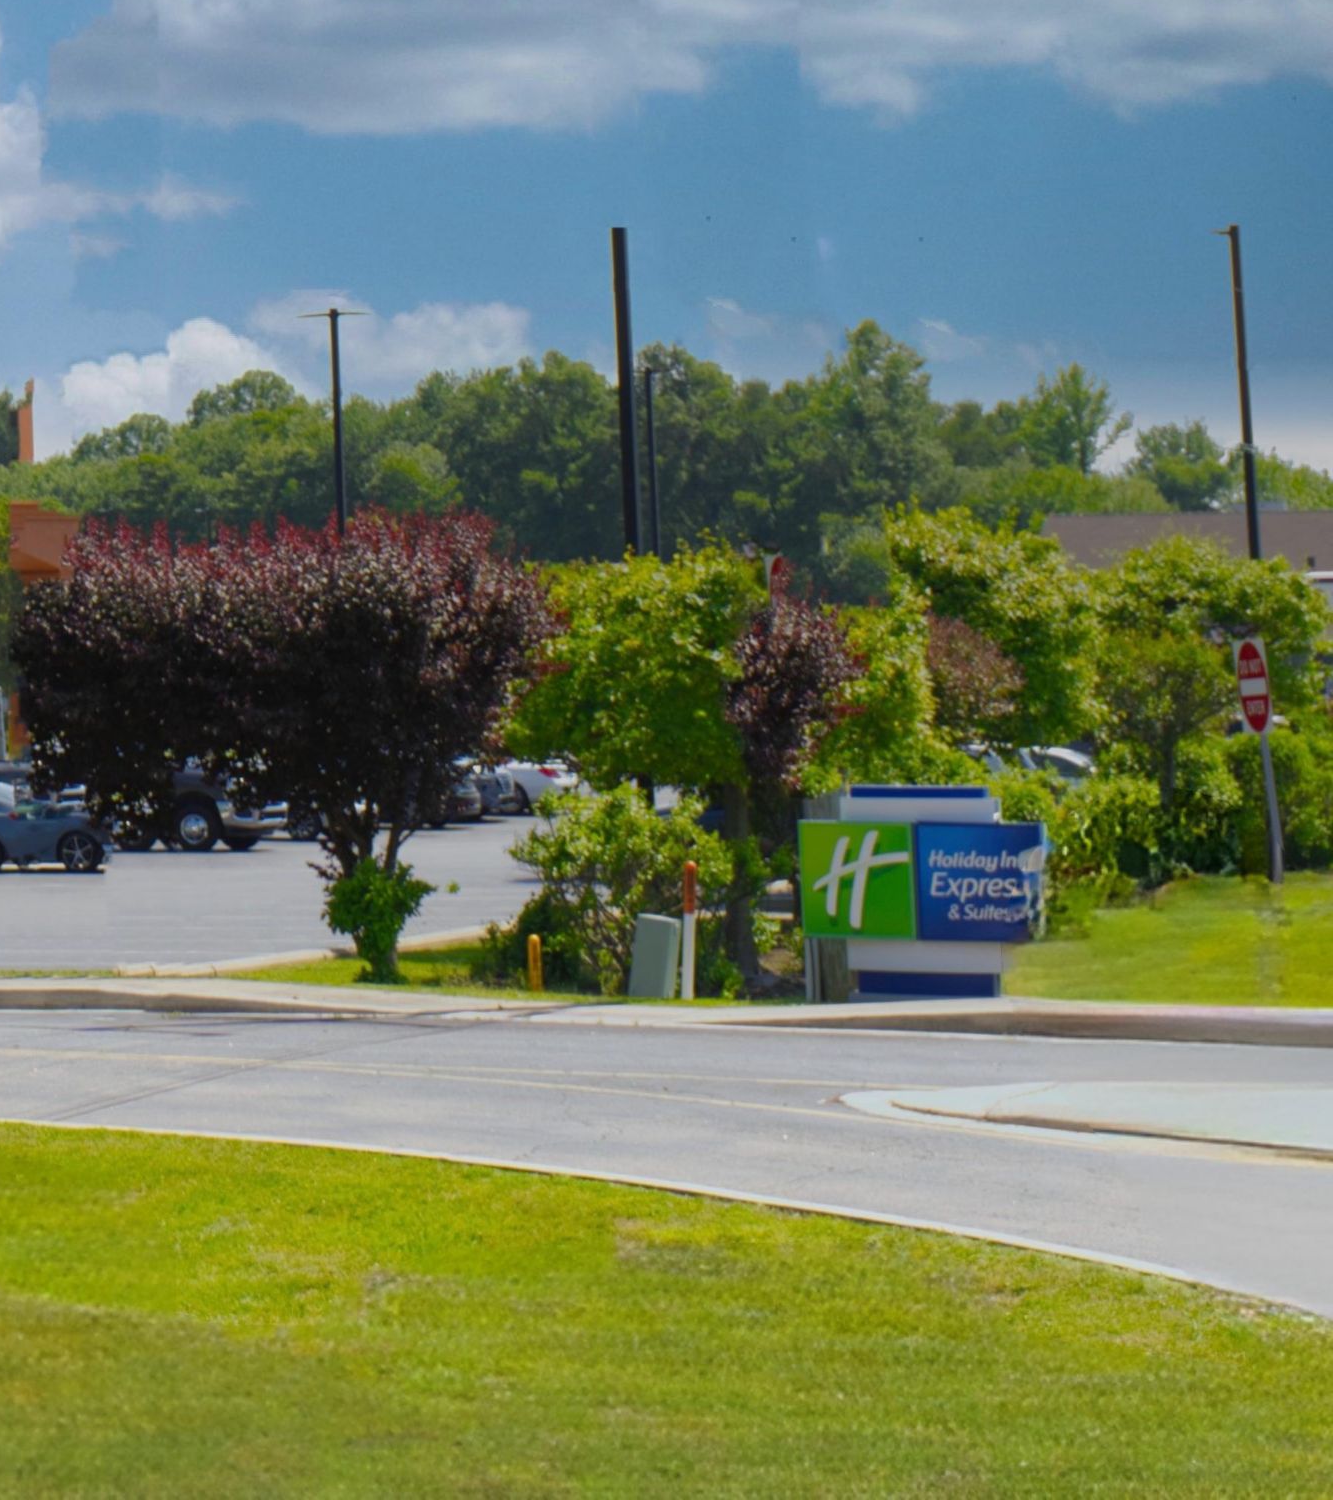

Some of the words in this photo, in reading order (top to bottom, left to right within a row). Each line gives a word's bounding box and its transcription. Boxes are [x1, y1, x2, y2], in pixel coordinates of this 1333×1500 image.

[928, 849, 998, 873] Holiday
[930, 871, 1028, 903] Expres
[947, 904, 961, 921] &
